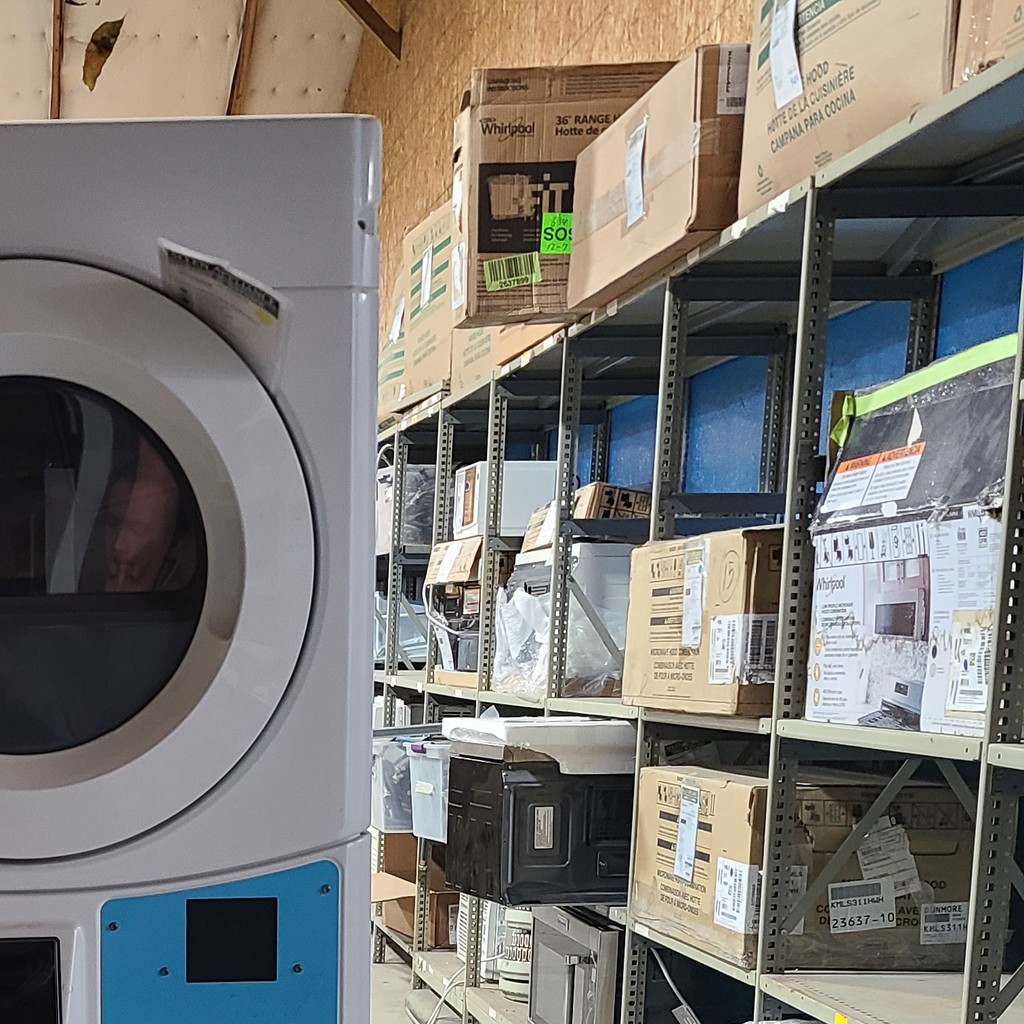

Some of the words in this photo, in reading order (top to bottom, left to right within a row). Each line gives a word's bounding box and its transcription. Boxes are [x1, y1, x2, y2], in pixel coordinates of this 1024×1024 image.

[806, 60, 829, 87] HOOD
[767, 110, 788, 135] HOTTE
[787, 104, 799, 121] DE
[800, 96, 810, 114] LA
[810, 65, 856, 107] CUISINIÈRE
[574, 114, 611, 124] RANGE
[770, 122, 805, 154] CAMPANA
[804, 109, 825, 132] PARA
[824, 88, 857, 118] COCINA
[479, 118, 535, 139] Whirlpool
[555, 126, 583, 136] Hotte
[586, 125, 599, 135] de
[816, 575, 846, 593] Whirlpool
[830, 896, 884, 909] KMLS311HWH
[898, 906, 920, 915] AVE
[924, 904, 962, 913] DUNMORE
[832, 912, 895, 929] 23637-10
